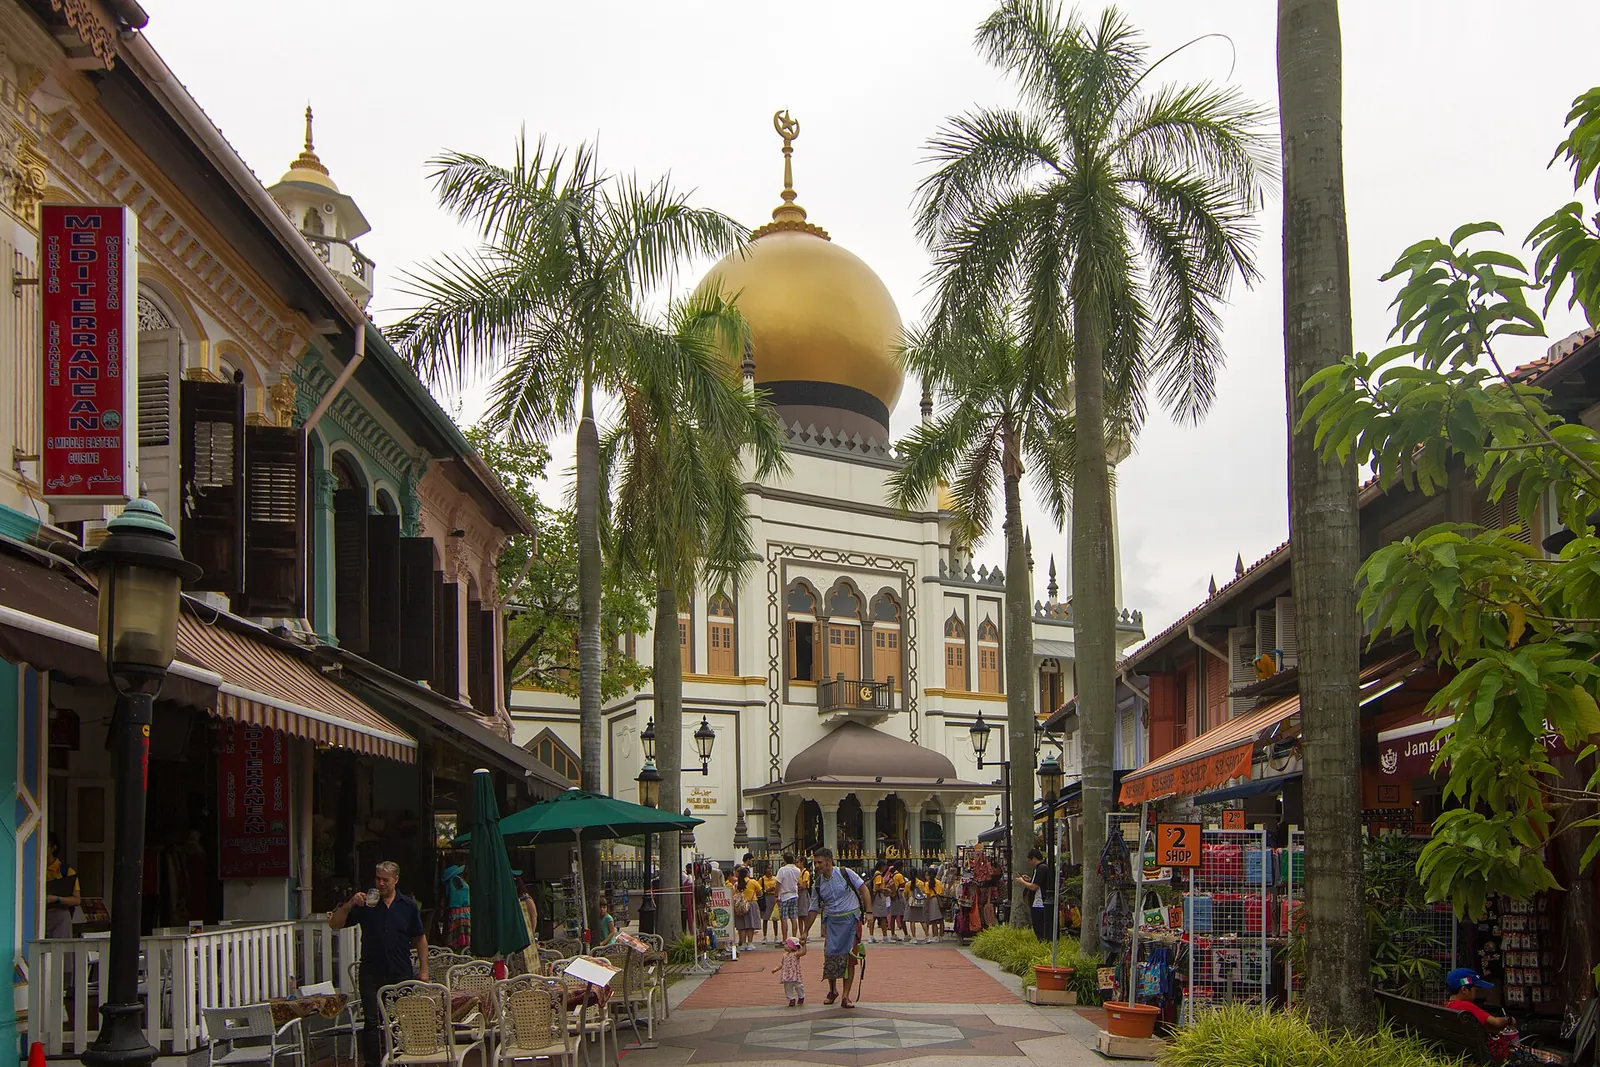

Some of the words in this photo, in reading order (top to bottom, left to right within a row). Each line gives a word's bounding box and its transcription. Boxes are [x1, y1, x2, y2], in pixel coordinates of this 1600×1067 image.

[48, 235, 60, 294] TURKISH
[106, 235, 120, 310] MORROCCAN
[64, 214, 102, 431] MEDITERRANEAN
[48, 320, 61, 387] LEBANESE
[107, 327, 119, 378] JORDAN
[55, 436, 85, 448] MIDDLE
[86, 436, 120, 448] EASTERN
[68, 452, 100, 464] CUISINE
[87, 468, 121, 490] مطعم
[1404, 739, 1440, 757] Jamal
[1190, 764, 1208, 783] SHOP
[1165, 850, 1192, 862] SHOP
[711, 891, 725, 899] ONEY
